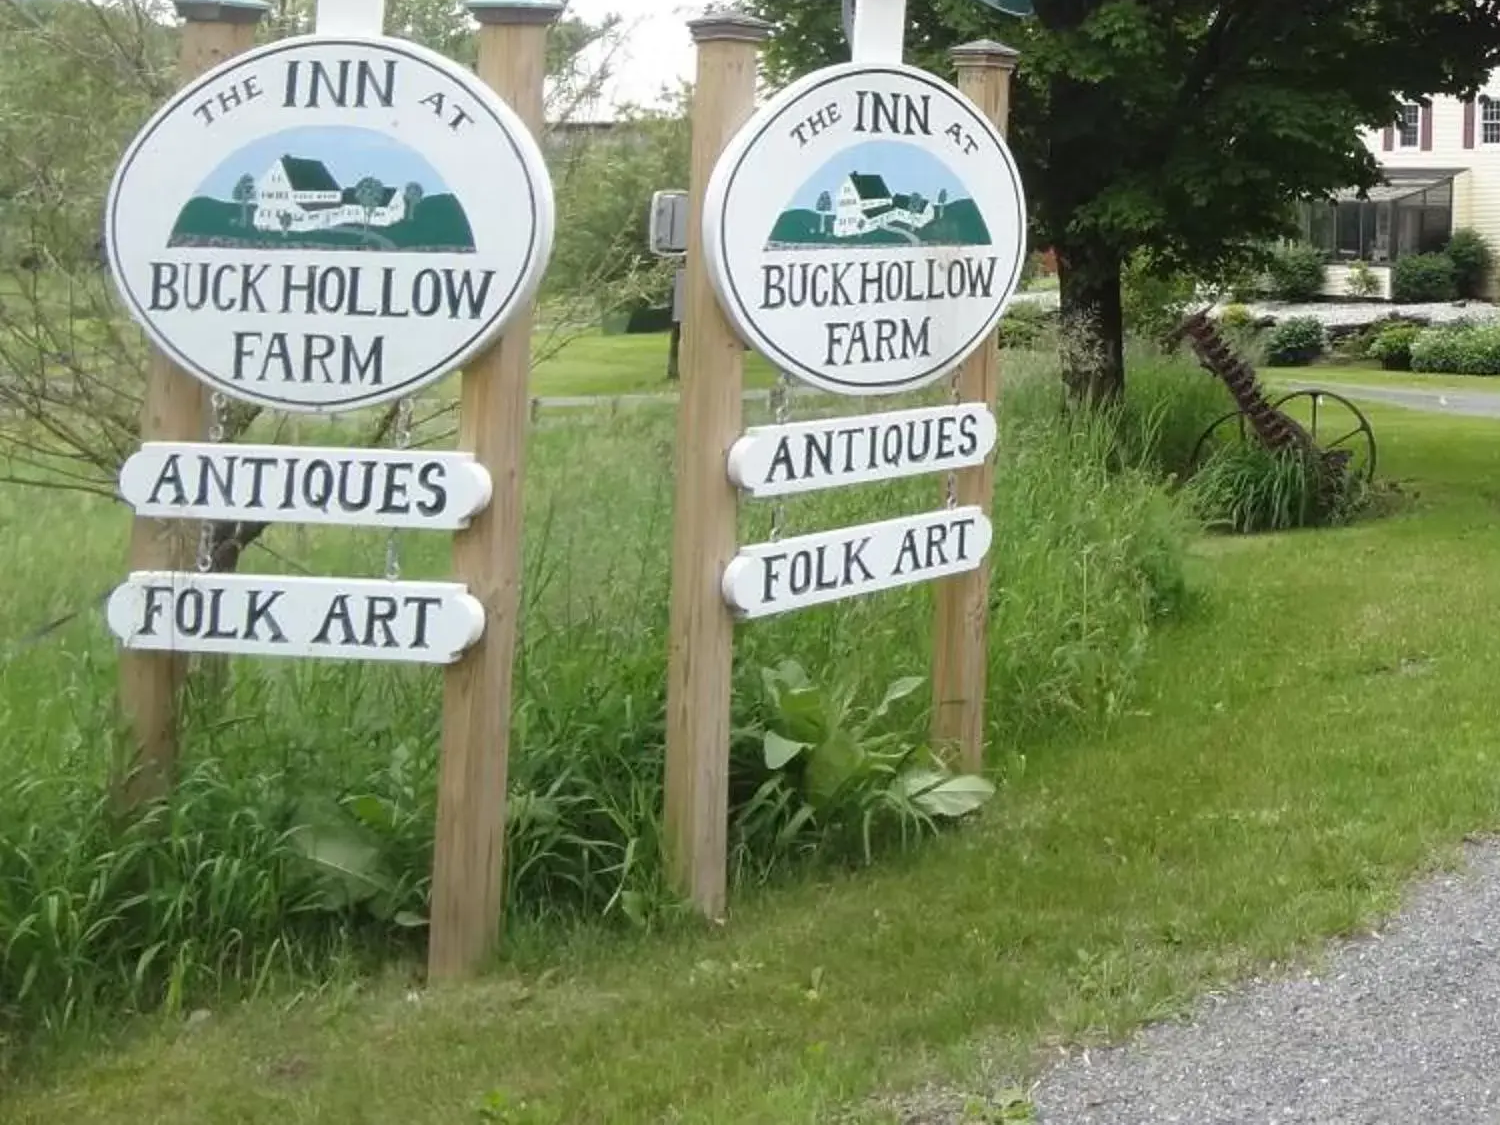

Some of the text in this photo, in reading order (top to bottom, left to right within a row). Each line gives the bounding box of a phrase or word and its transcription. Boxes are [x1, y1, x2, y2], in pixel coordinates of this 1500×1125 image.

[192, 59, 476, 132] THE INN AT
[790, 91, 979, 156] THE INN AT
[148, 262, 497, 320] BUCK HOLLOW
[759, 256, 999, 310] BUCK HOLLOW
[232, 331, 384, 385] FARM
[823, 316, 931, 366] FARM
[764, 414, 978, 484] ANTIQUES
[147, 453, 448, 518] ANTIQUES
[761, 518, 975, 604] FOLK ART
[137, 585, 442, 649] FOLK ART
